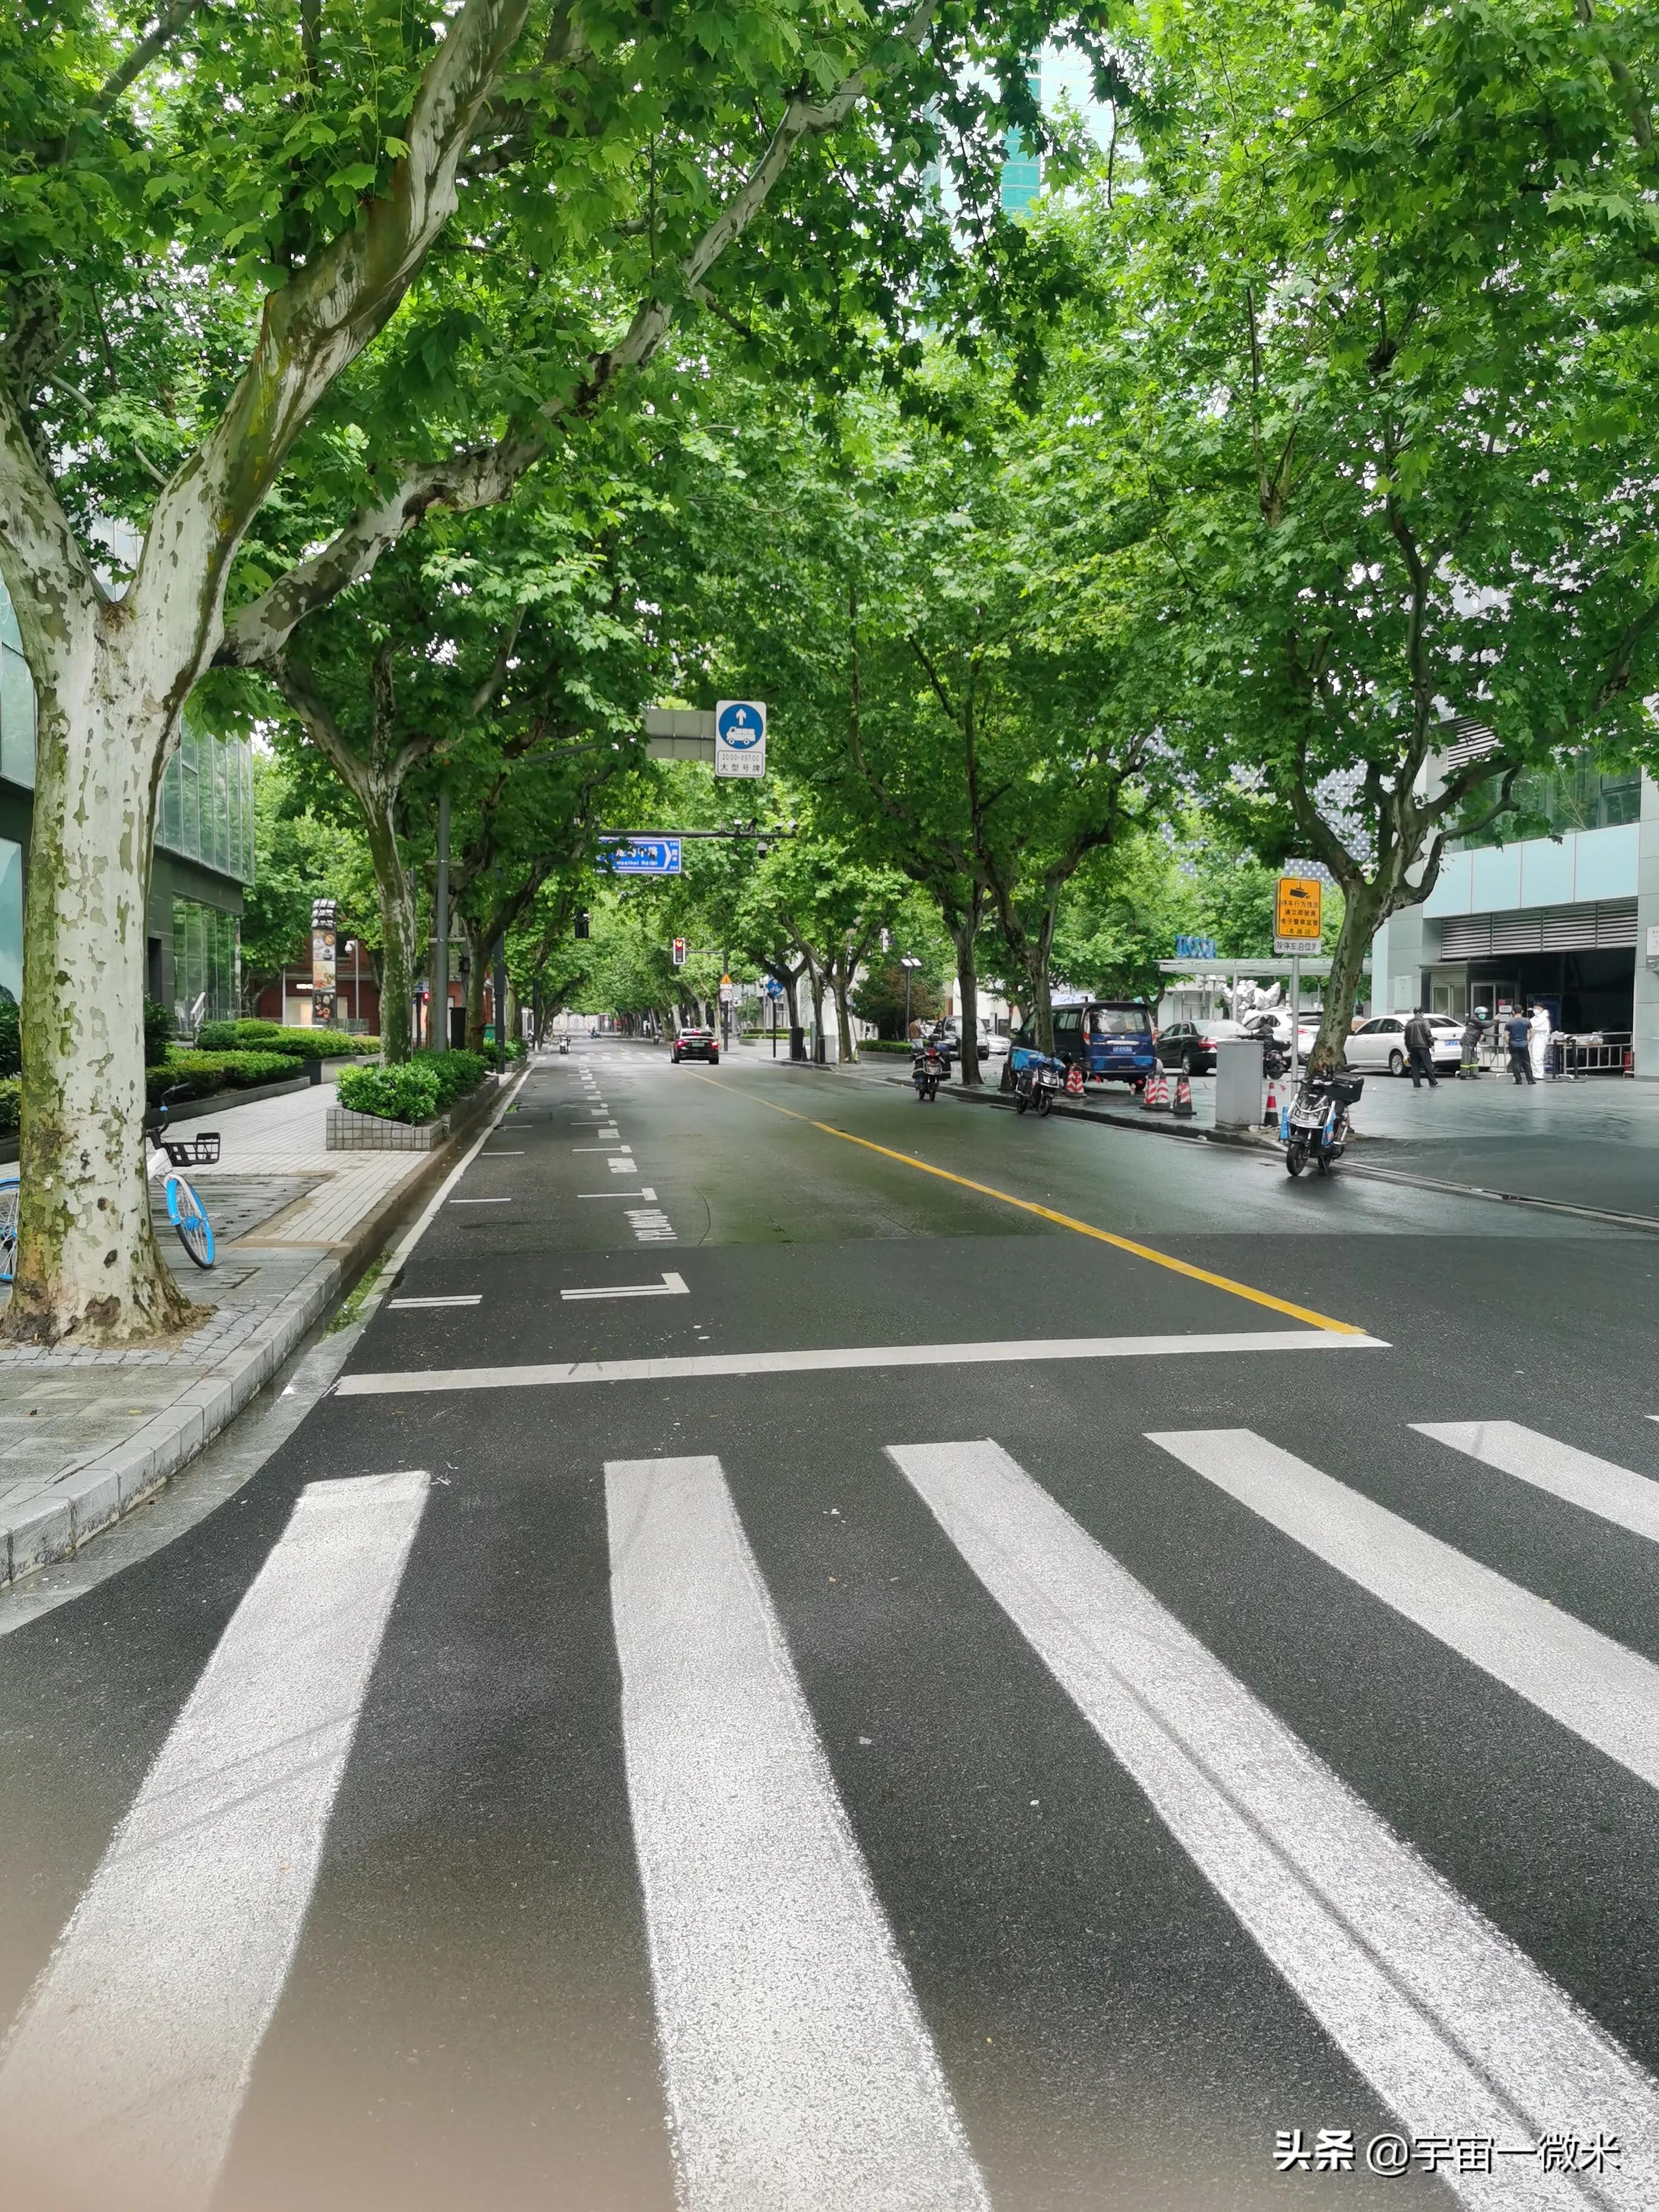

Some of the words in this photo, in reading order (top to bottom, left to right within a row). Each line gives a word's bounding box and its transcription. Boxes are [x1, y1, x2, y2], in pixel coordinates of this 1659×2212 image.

[720, 763, 760, 772] 大型号牌
[1276, 941, 1317, 951] 除停车泊位外
